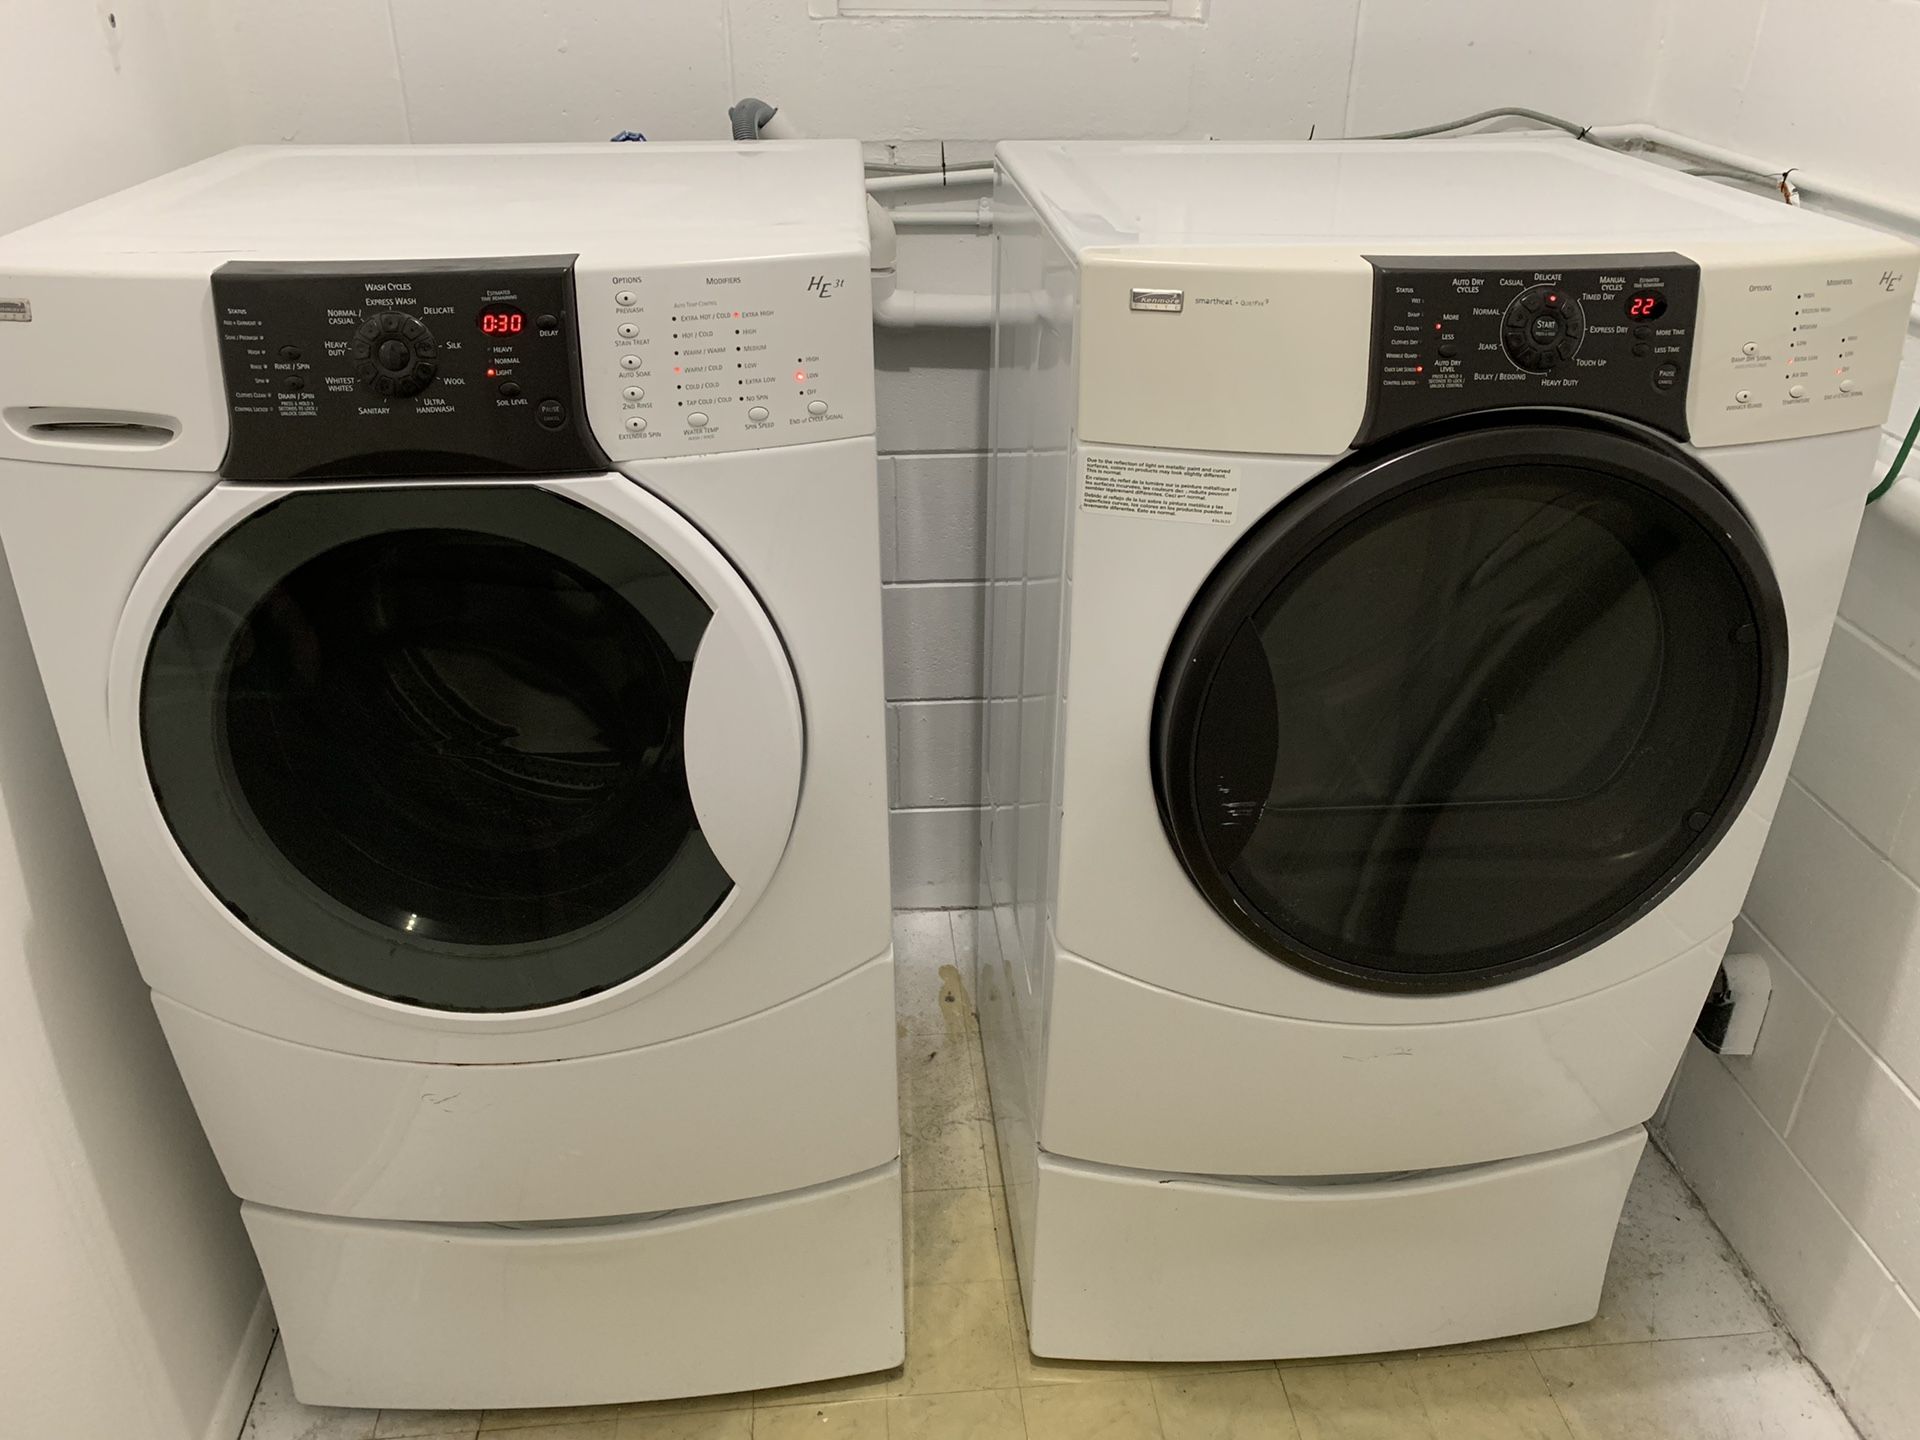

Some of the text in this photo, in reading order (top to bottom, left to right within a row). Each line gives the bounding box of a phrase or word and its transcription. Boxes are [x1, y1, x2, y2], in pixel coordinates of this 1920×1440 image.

[387, 283, 412, 291] CYCLES
[1631, 299, 1654, 315] 22
[484, 315, 521, 332] 0:30
